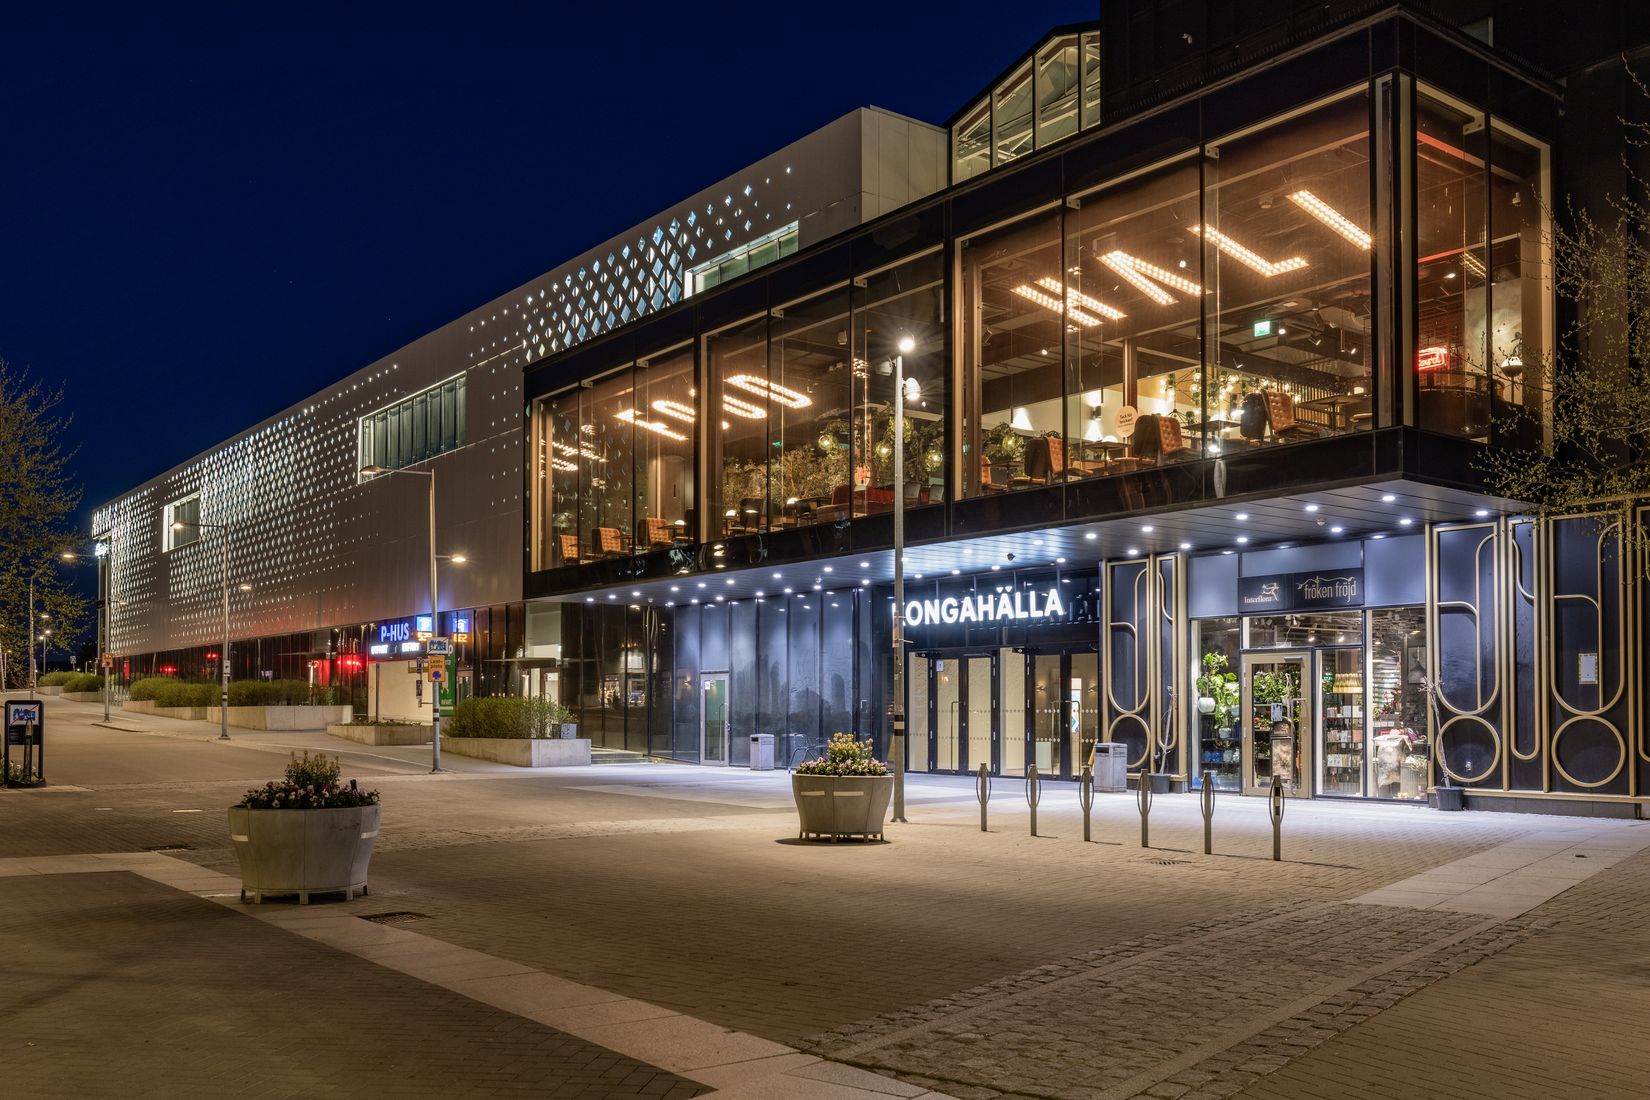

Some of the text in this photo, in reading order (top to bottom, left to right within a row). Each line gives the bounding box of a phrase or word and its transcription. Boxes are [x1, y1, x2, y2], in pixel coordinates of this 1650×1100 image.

[1244, 595, 1272, 604] Interflora
[1304, 579, 1357, 603] fröken fröjd
[381, 623, 410, 642] P-HUS
